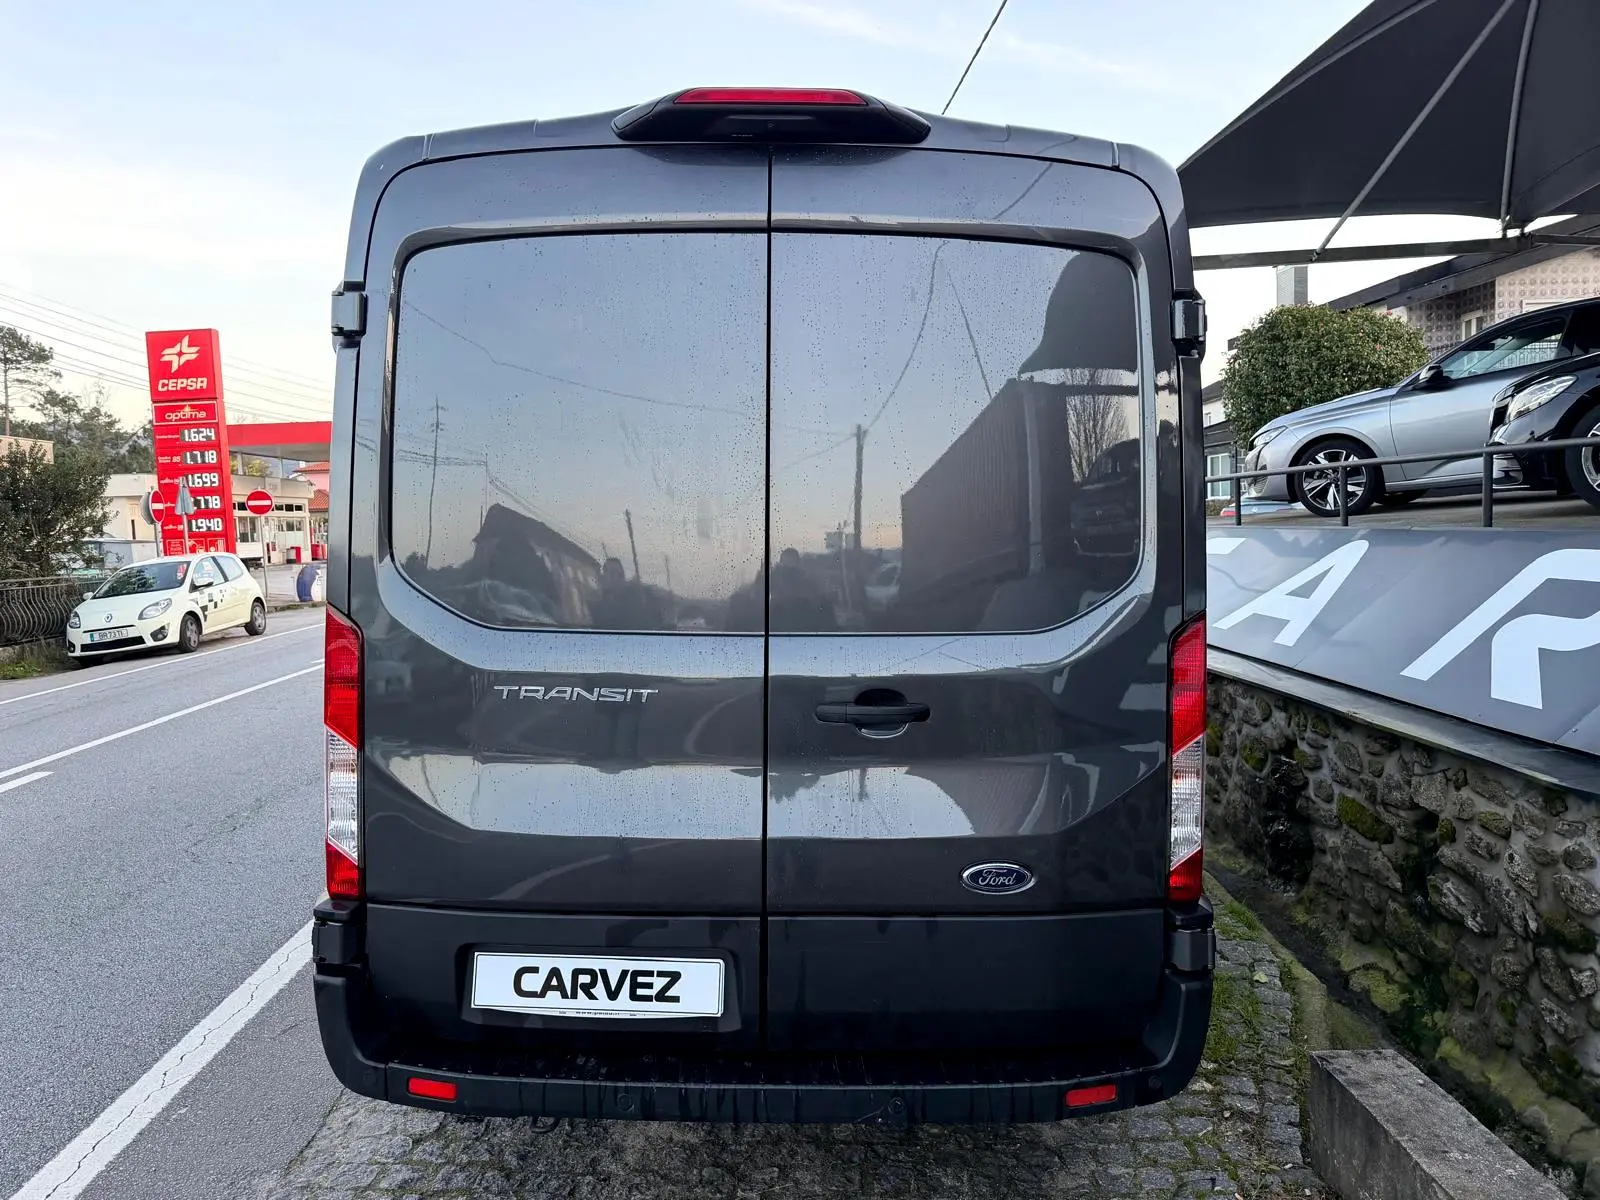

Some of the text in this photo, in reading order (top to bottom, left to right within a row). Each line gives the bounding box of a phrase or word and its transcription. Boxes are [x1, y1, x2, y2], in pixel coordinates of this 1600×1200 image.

[157, 377, 208, 392] CEPSA
[164, 409, 207, 422] optima
[184, 428, 216, 442] 1.624
[186, 450, 217, 465] 1.718
[188, 472, 219, 488] 1.699
[191, 495, 221, 510] .778
[191, 517, 223, 532] 1.940
[1206, 537, 1600, 710] AR
[493, 685, 659, 703] TRANSIT
[978, 868, 1017, 886] Ford
[512, 965, 683, 1004] CARVEZ
